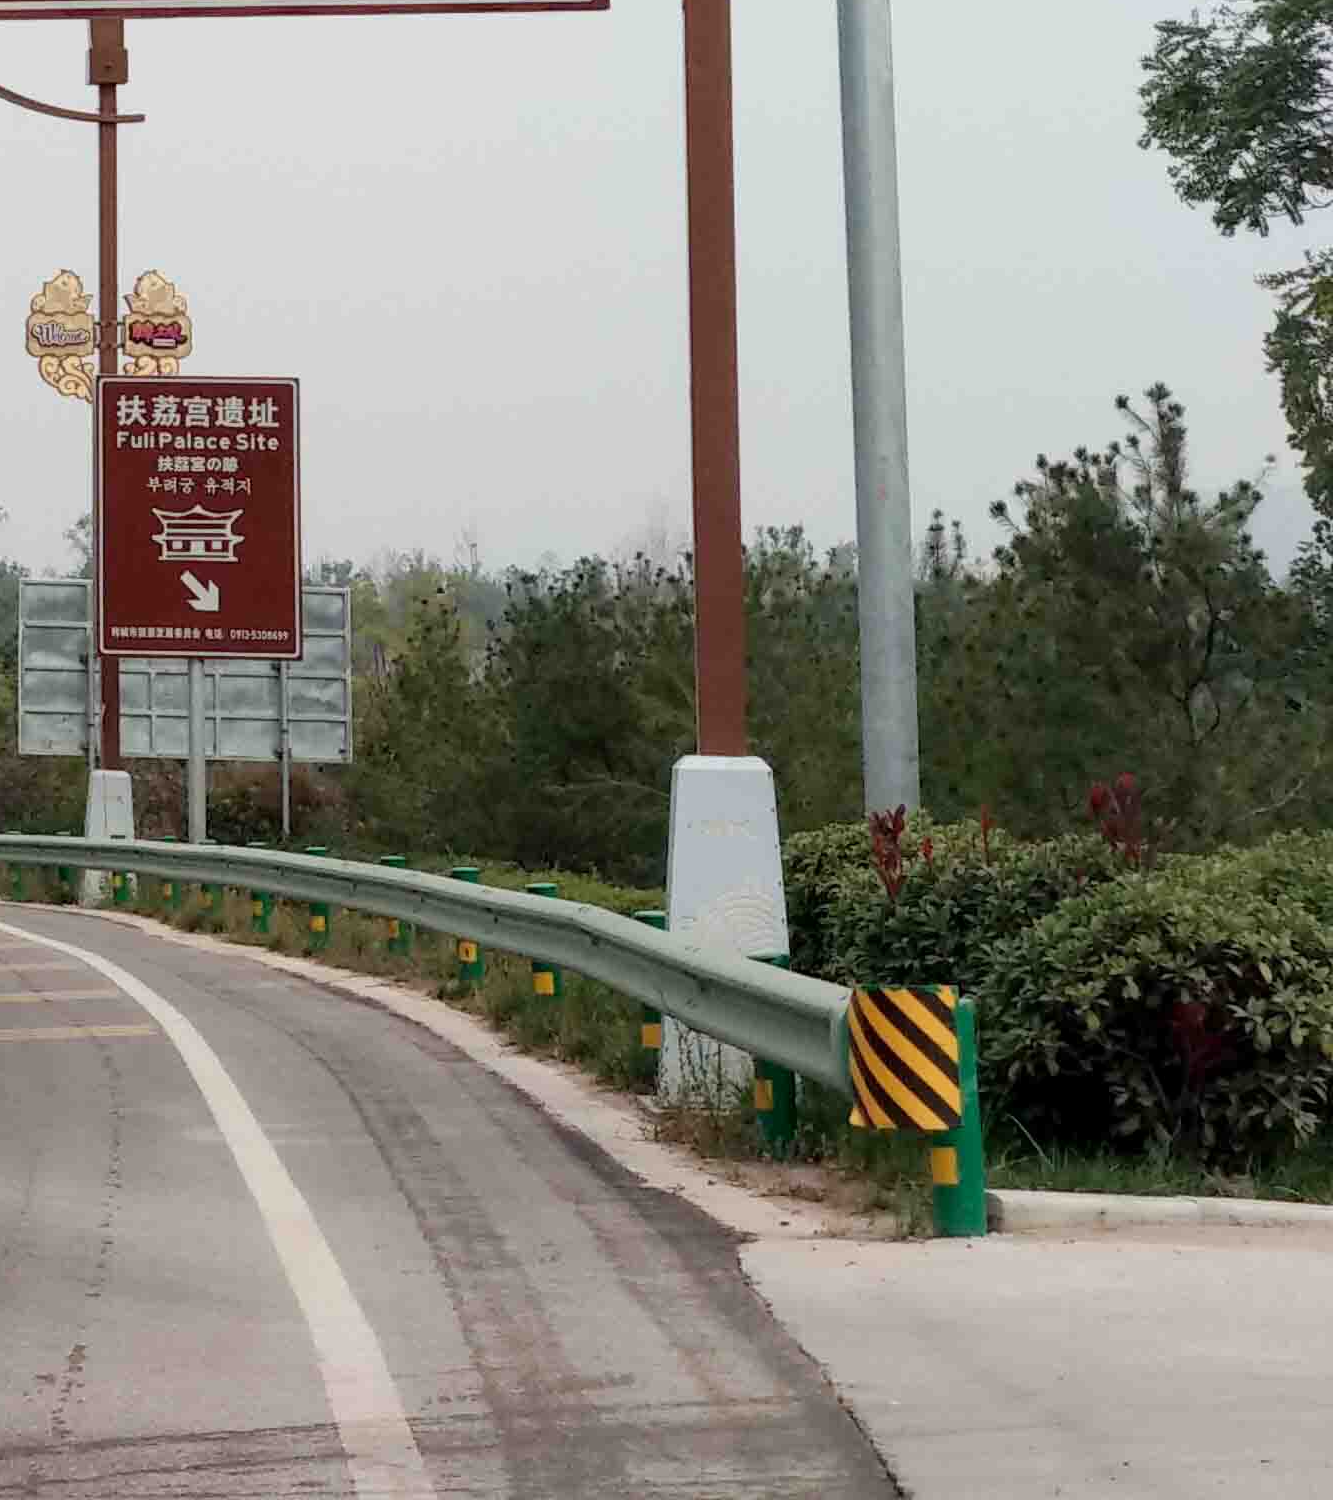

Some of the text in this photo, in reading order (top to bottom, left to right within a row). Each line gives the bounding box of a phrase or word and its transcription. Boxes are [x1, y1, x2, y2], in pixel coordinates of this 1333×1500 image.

[116, 395, 280, 428] 扶荔宫遗址
[116, 431, 281, 450] Fuli Palace Site
